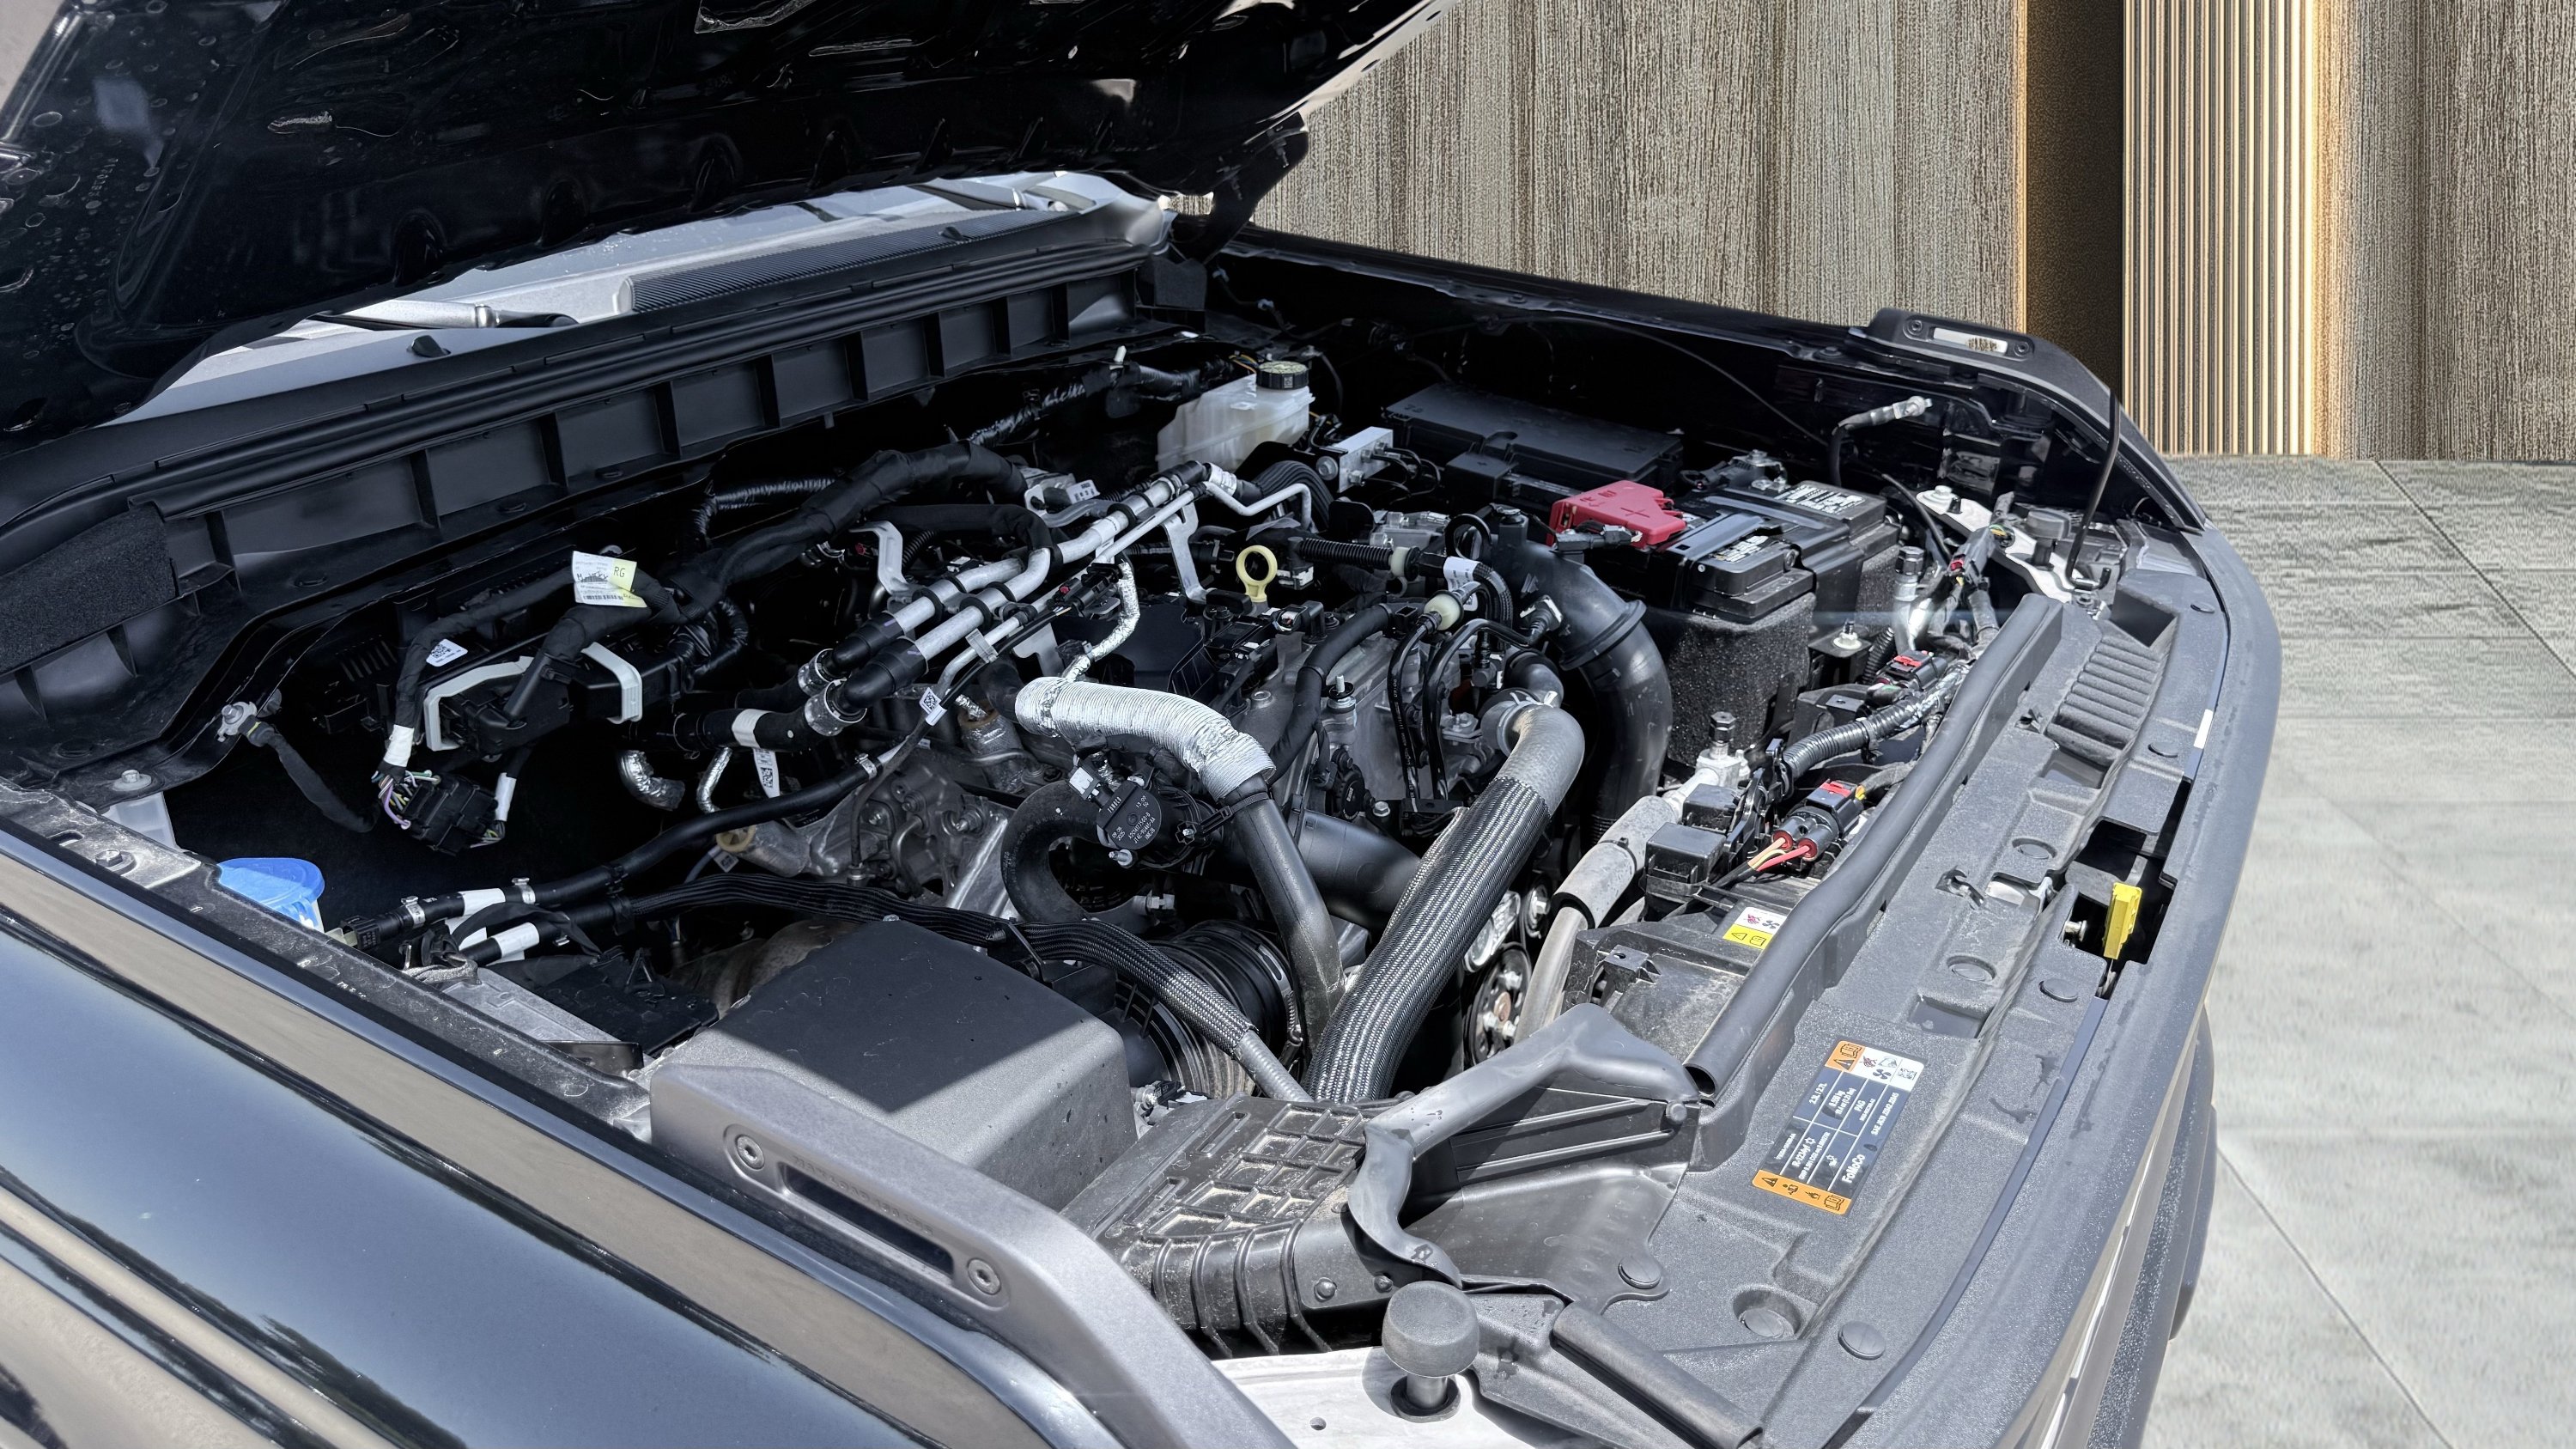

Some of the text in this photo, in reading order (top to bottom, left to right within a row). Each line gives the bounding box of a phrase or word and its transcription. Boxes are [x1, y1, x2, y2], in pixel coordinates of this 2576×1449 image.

[614, 566, 626, 577] RG
[1854, 1099, 1865, 1111] PAG
[1870, 1123, 1881, 1135] SAE
[1792, 1144, 1811, 1166] R-1234yf
[1842, 1154, 1865, 1183] FoMoCo
